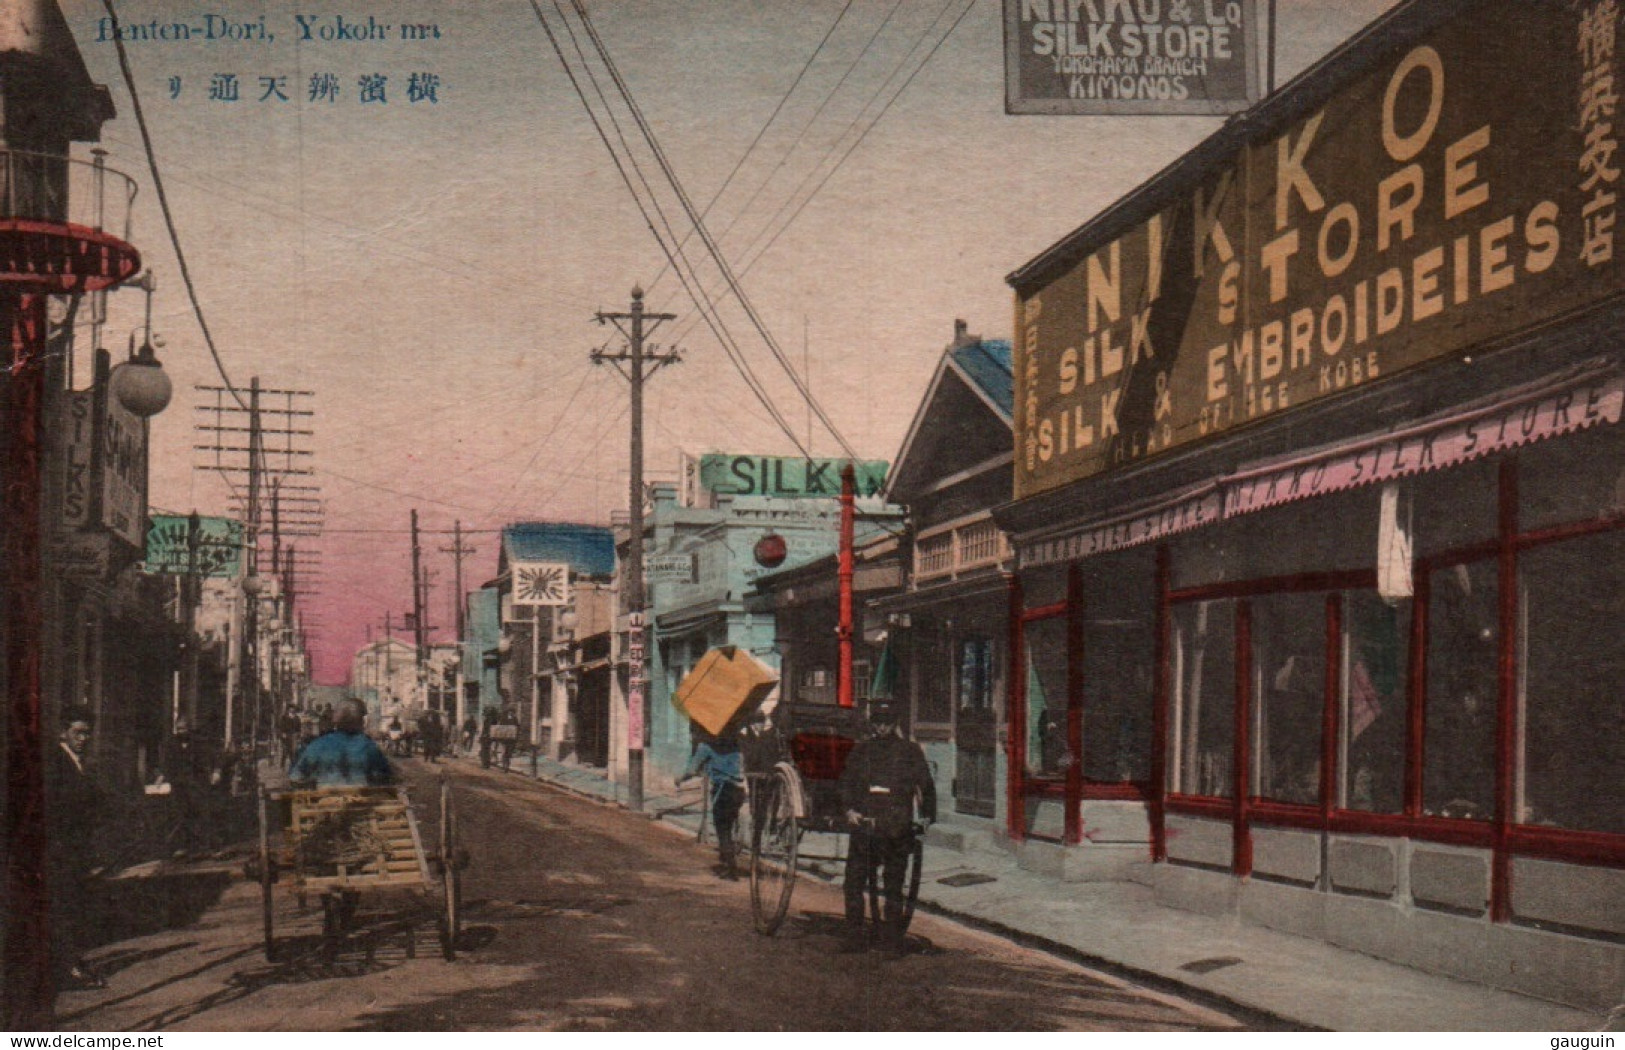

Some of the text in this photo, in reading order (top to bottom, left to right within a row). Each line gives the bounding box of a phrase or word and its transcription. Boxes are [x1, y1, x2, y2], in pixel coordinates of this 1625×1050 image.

[1032, 22, 1232, 59] SILK STORE
[1050, 56, 1139, 75] YOKOHAMA
[1069, 75, 1189, 100] KIMONOS
[1087, 45, 1445, 334] NIKKO
[1059, 306, 1154, 395] SILK
[1217, 124, 1491, 326] STORE
[1038, 388, 1121, 462] SILK
[1206, 200, 1561, 402] EMBROIDEIES
[1318, 350, 1380, 393] KOBE
[1463, 386, 1600, 453] STORE
[64, 396, 88, 519] SILKS
[730, 456, 831, 495] SILK
